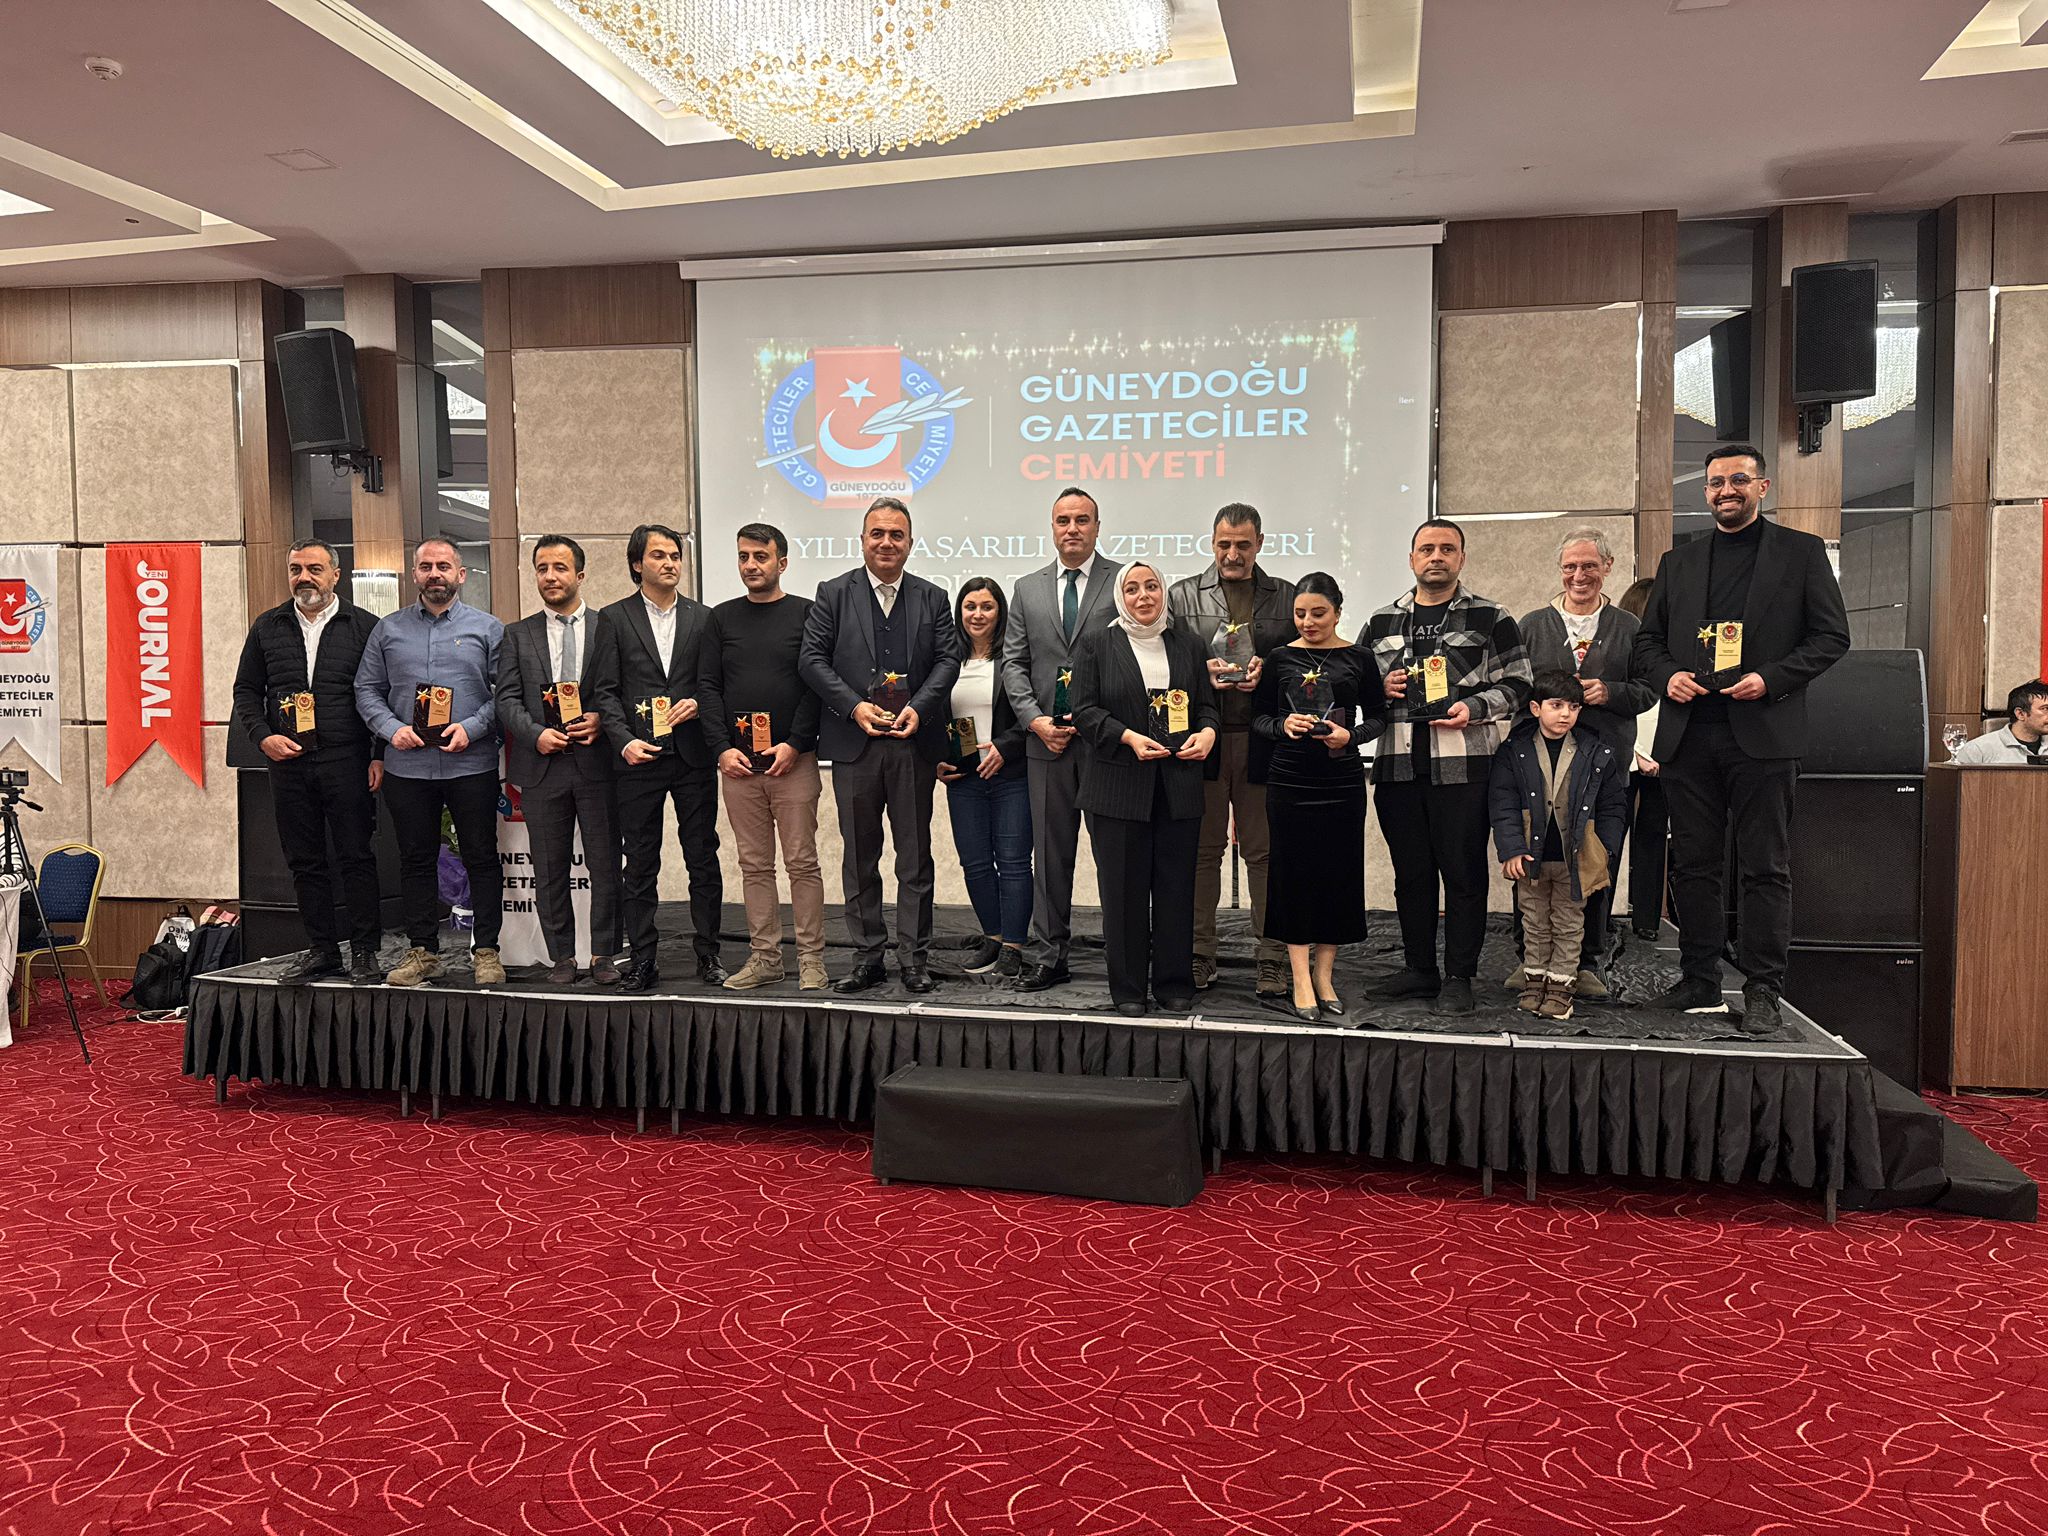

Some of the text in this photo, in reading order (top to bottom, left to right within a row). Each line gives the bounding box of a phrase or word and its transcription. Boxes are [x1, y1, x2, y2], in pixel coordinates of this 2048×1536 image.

[1020, 360, 1308, 403] GÜNEYDOĞU
[1020, 403, 1309, 442] GAZETECİLER
[1020, 442, 1226, 481] CEMİYETİ
[829, 480, 907, 492] GÜNEYDOĞU
[793, 536, 863, 559] YILI
[909, 534, 1046, 563] AŞARILI
[136, 560, 172, 728] JOURNAL
